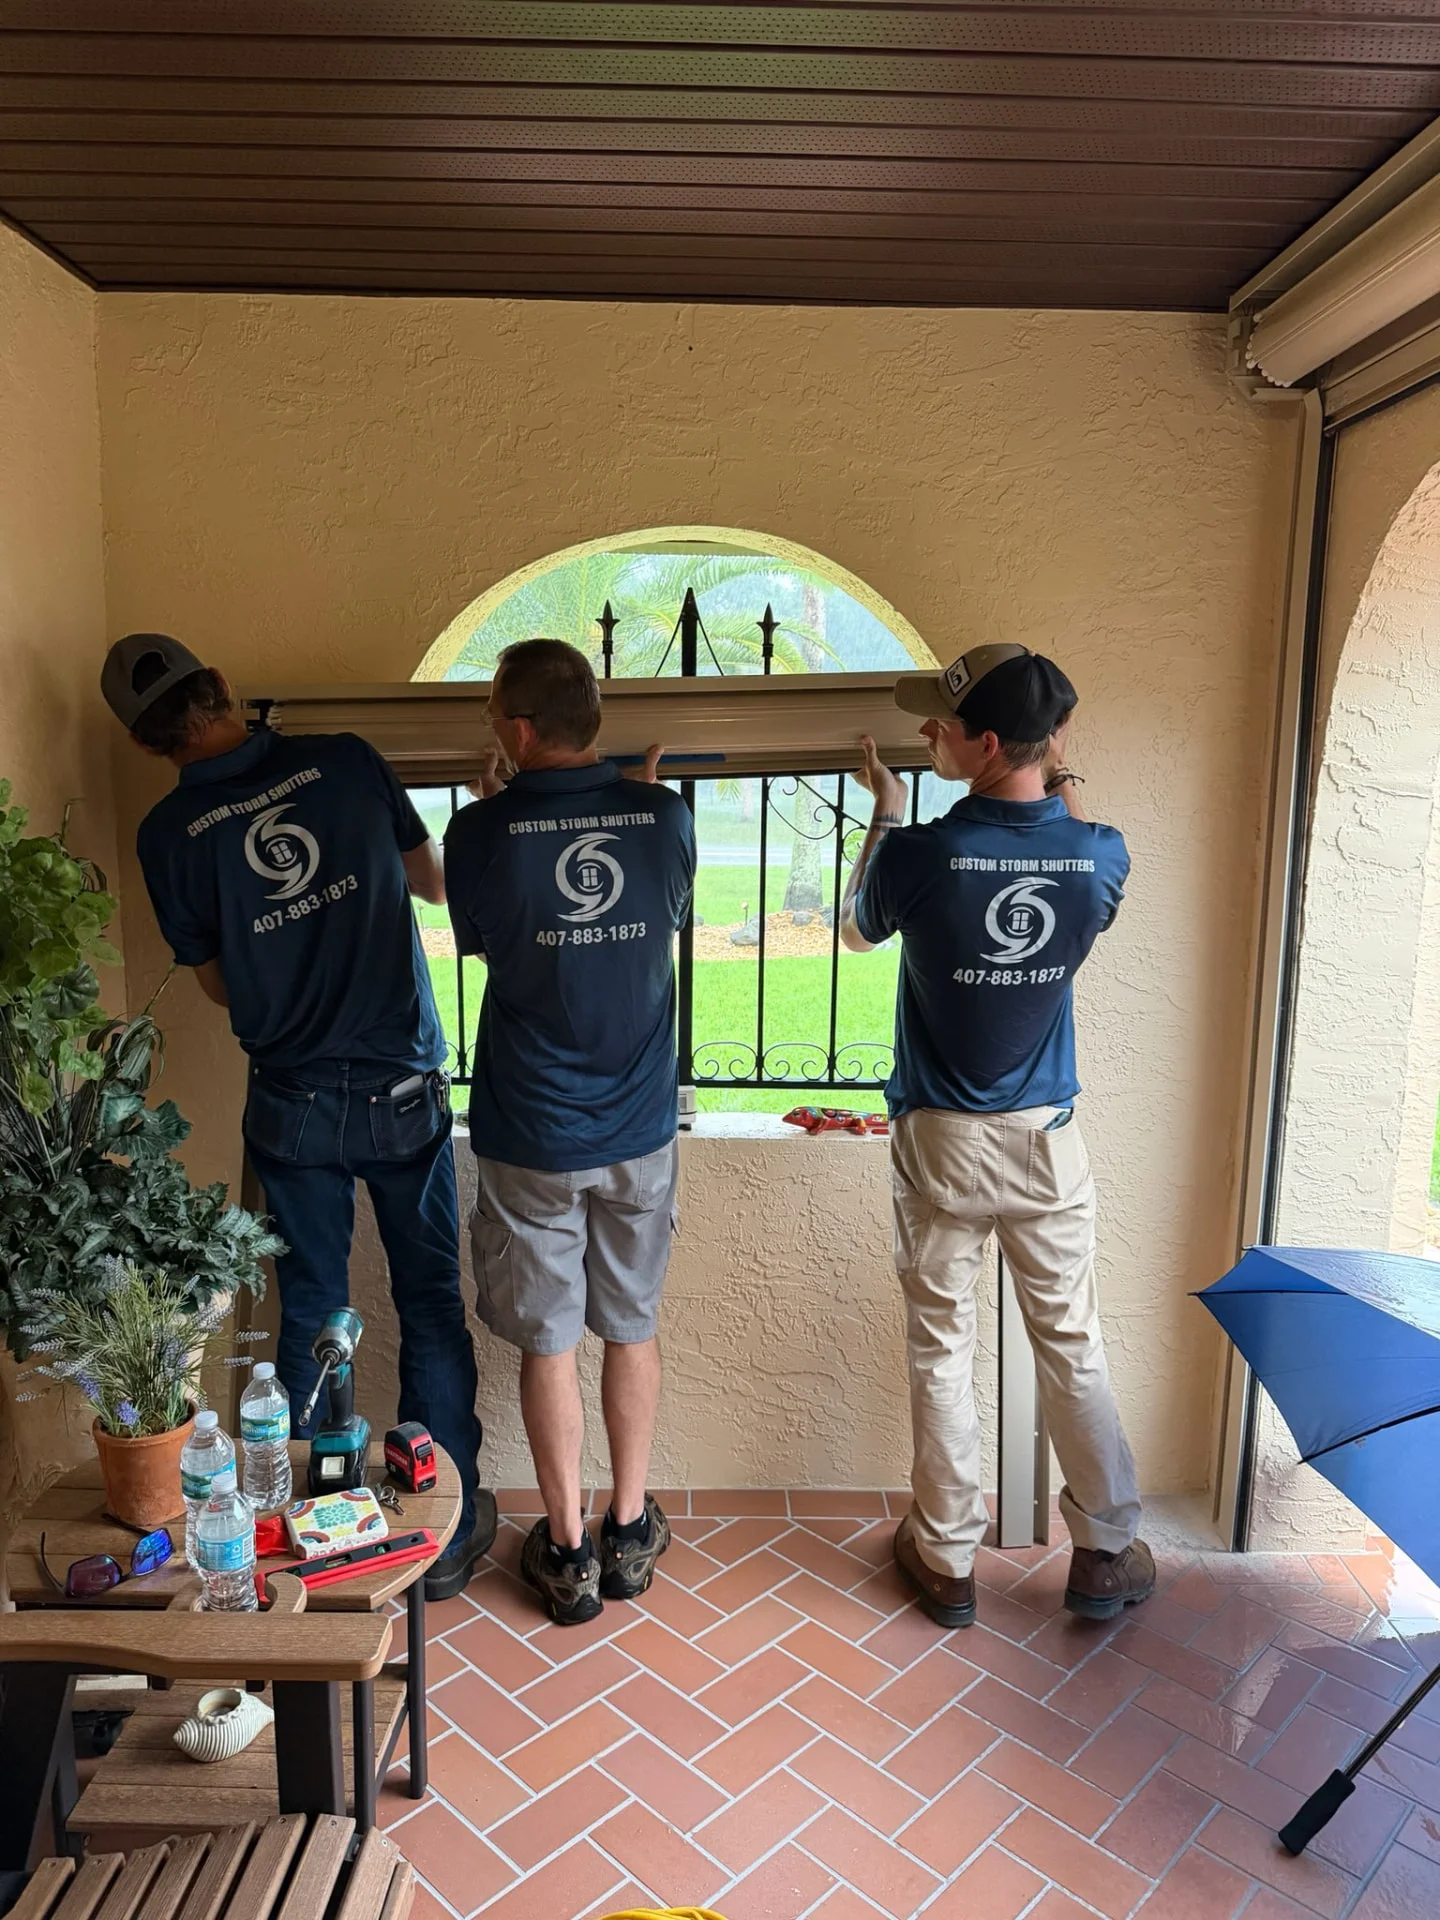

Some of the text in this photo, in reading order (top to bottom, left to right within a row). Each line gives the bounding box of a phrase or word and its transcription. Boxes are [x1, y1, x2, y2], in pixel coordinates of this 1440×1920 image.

[187, 767, 322, 837] CUSTOM STORM SHUTTERS
[508, 812, 656, 835] CUSTOM STORM SHUTTERS
[950, 857, 1095, 873] CUSTOM STORM SHUTTERS
[253, 874, 358, 934] 407-883-1873
[536, 922, 646, 946] 407-883-1873
[952, 965, 1066, 986] 407-883-1873
